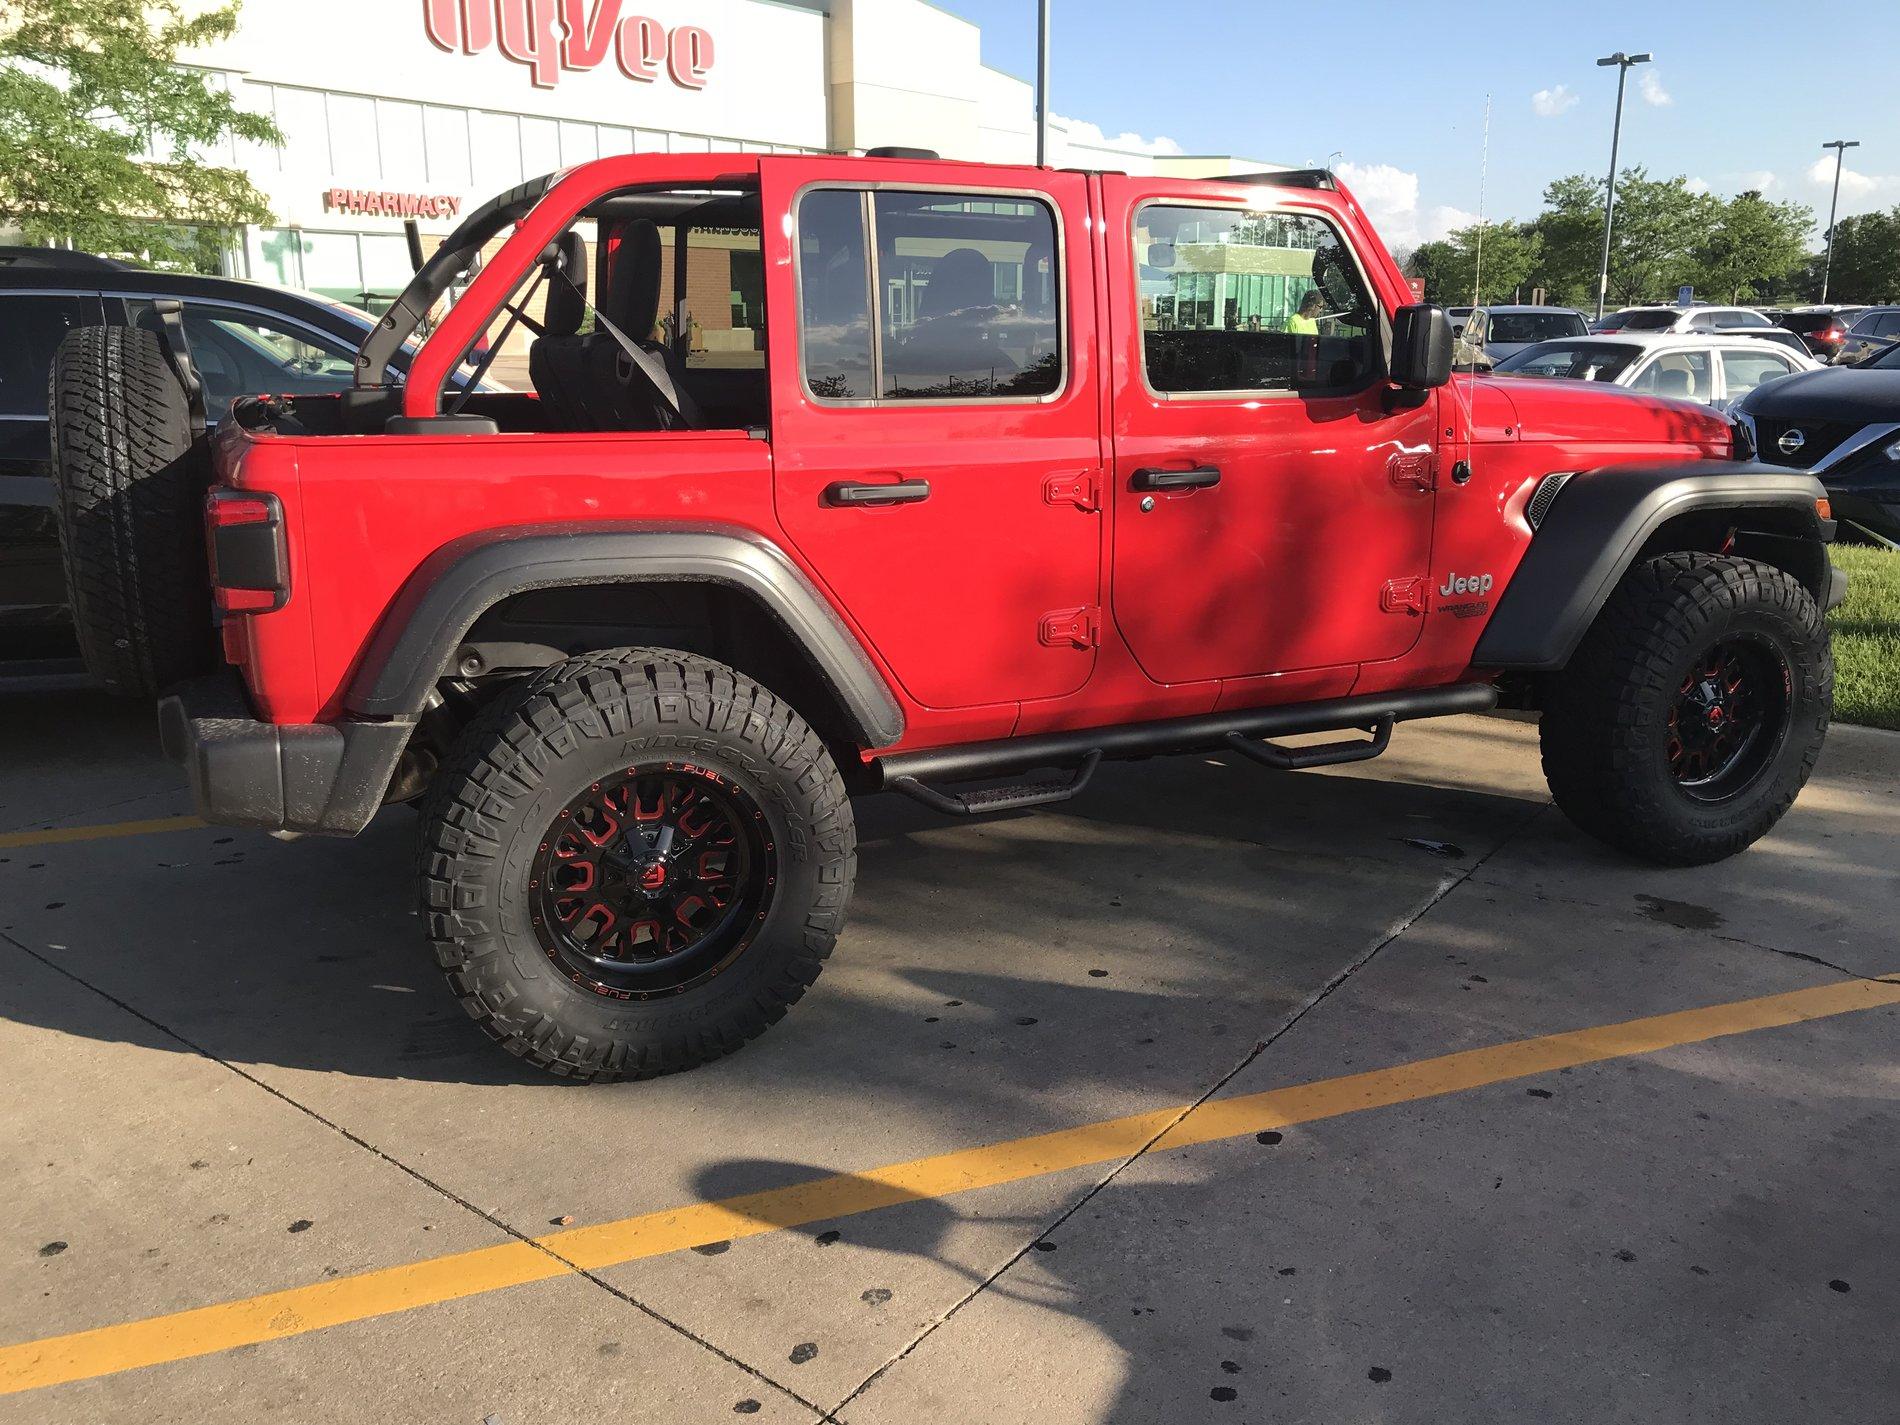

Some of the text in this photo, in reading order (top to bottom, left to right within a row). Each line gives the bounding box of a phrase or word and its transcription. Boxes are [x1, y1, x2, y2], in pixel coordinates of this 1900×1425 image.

[329, 188, 462, 216] PHARMACY
[1440, 572, 1493, 596] Jeep
[620, 734, 718, 758] RIDGE
[683, 764, 725, 785] FUEL
[589, 981, 631, 1000] FUEL
